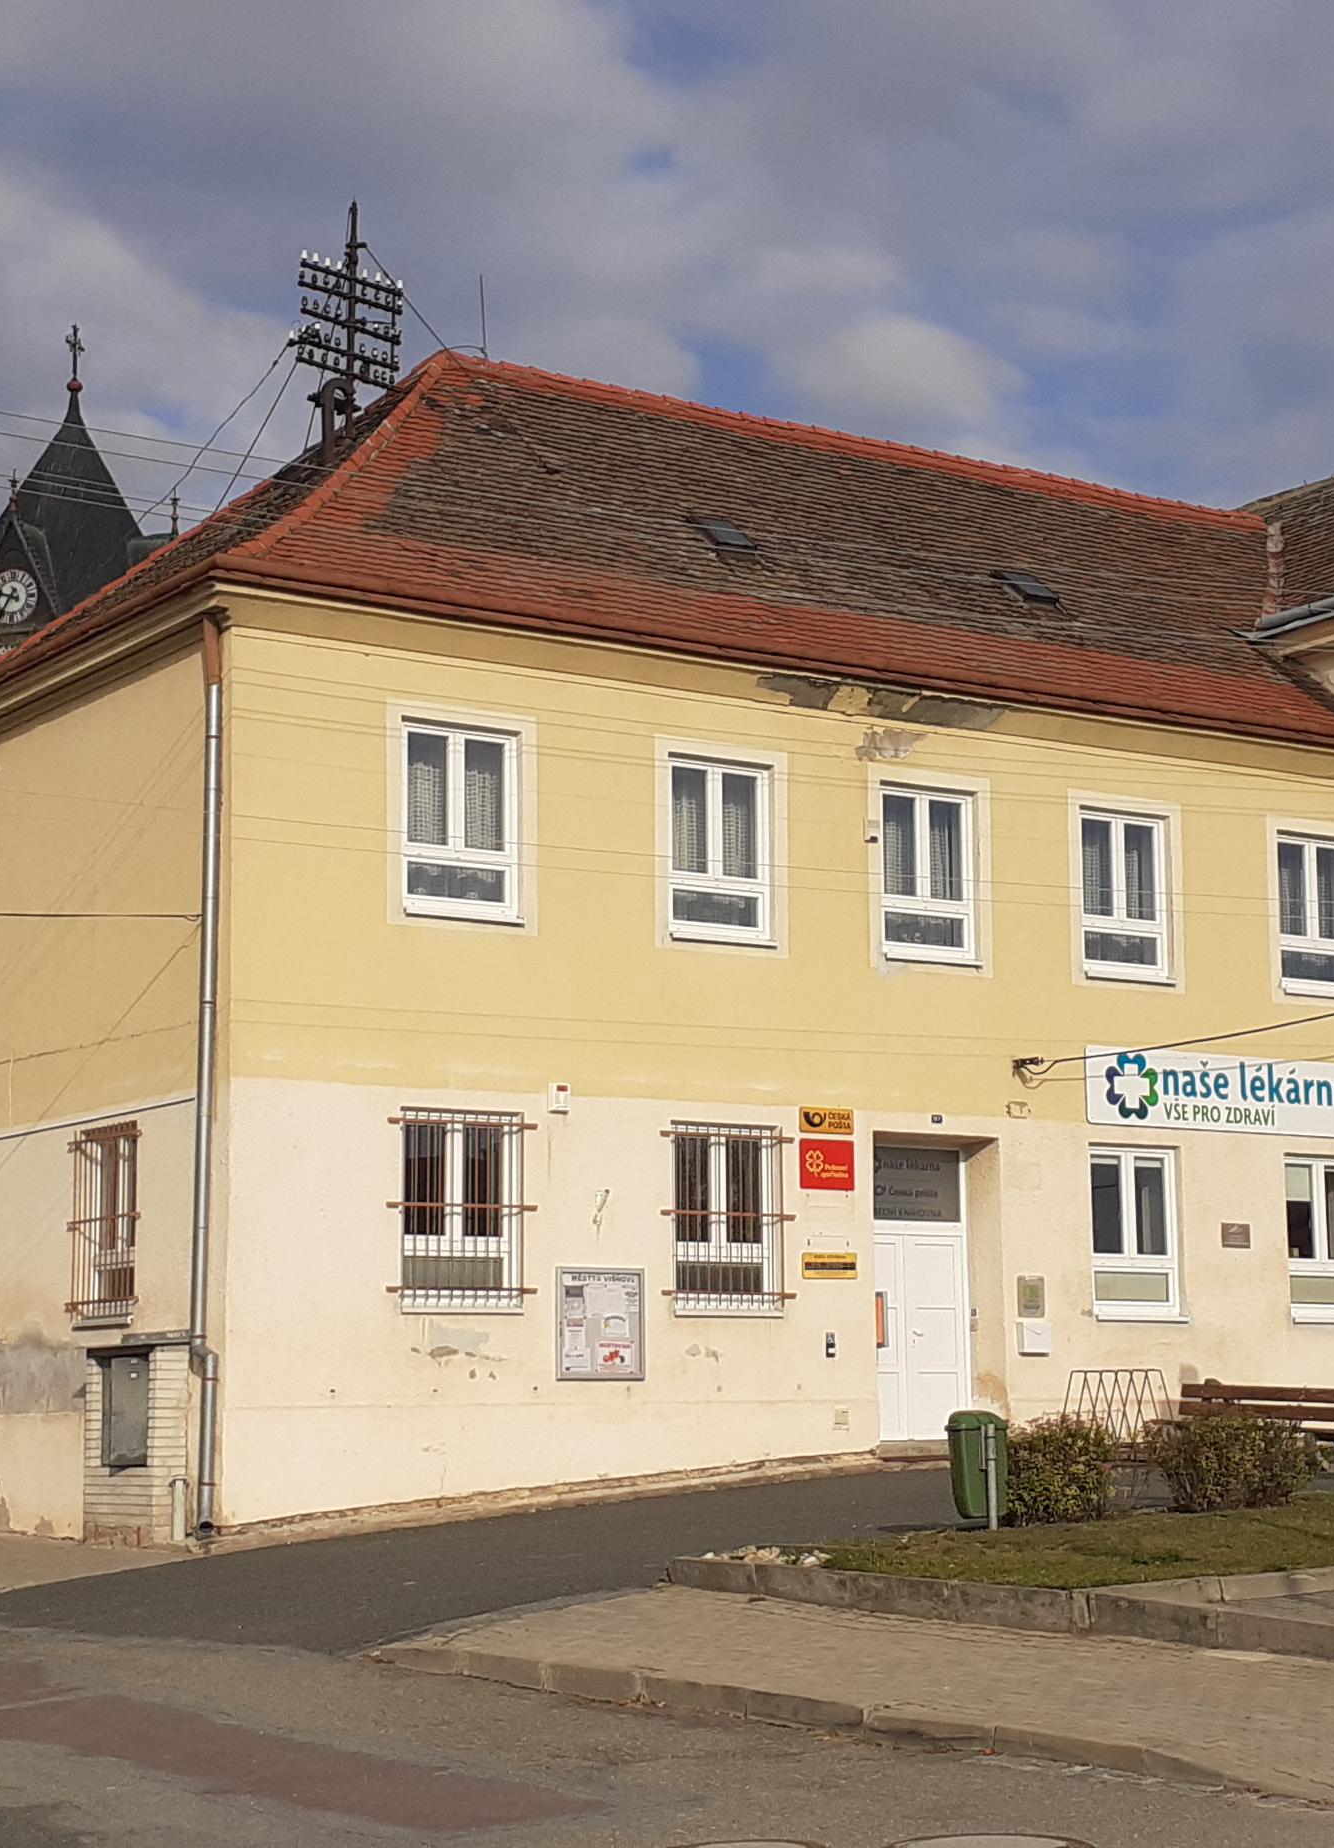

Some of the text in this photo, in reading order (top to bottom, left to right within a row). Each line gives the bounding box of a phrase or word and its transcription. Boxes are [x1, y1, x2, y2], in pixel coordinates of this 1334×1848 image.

[1162, 1061, 1229, 1100] naše
[828, 1111, 851, 1120] ČESKÁ
[1163, 1099, 1276, 1126] VŠE PRO ZDRAVÍ
[828, 1120, 852, 1129] POŠTA
